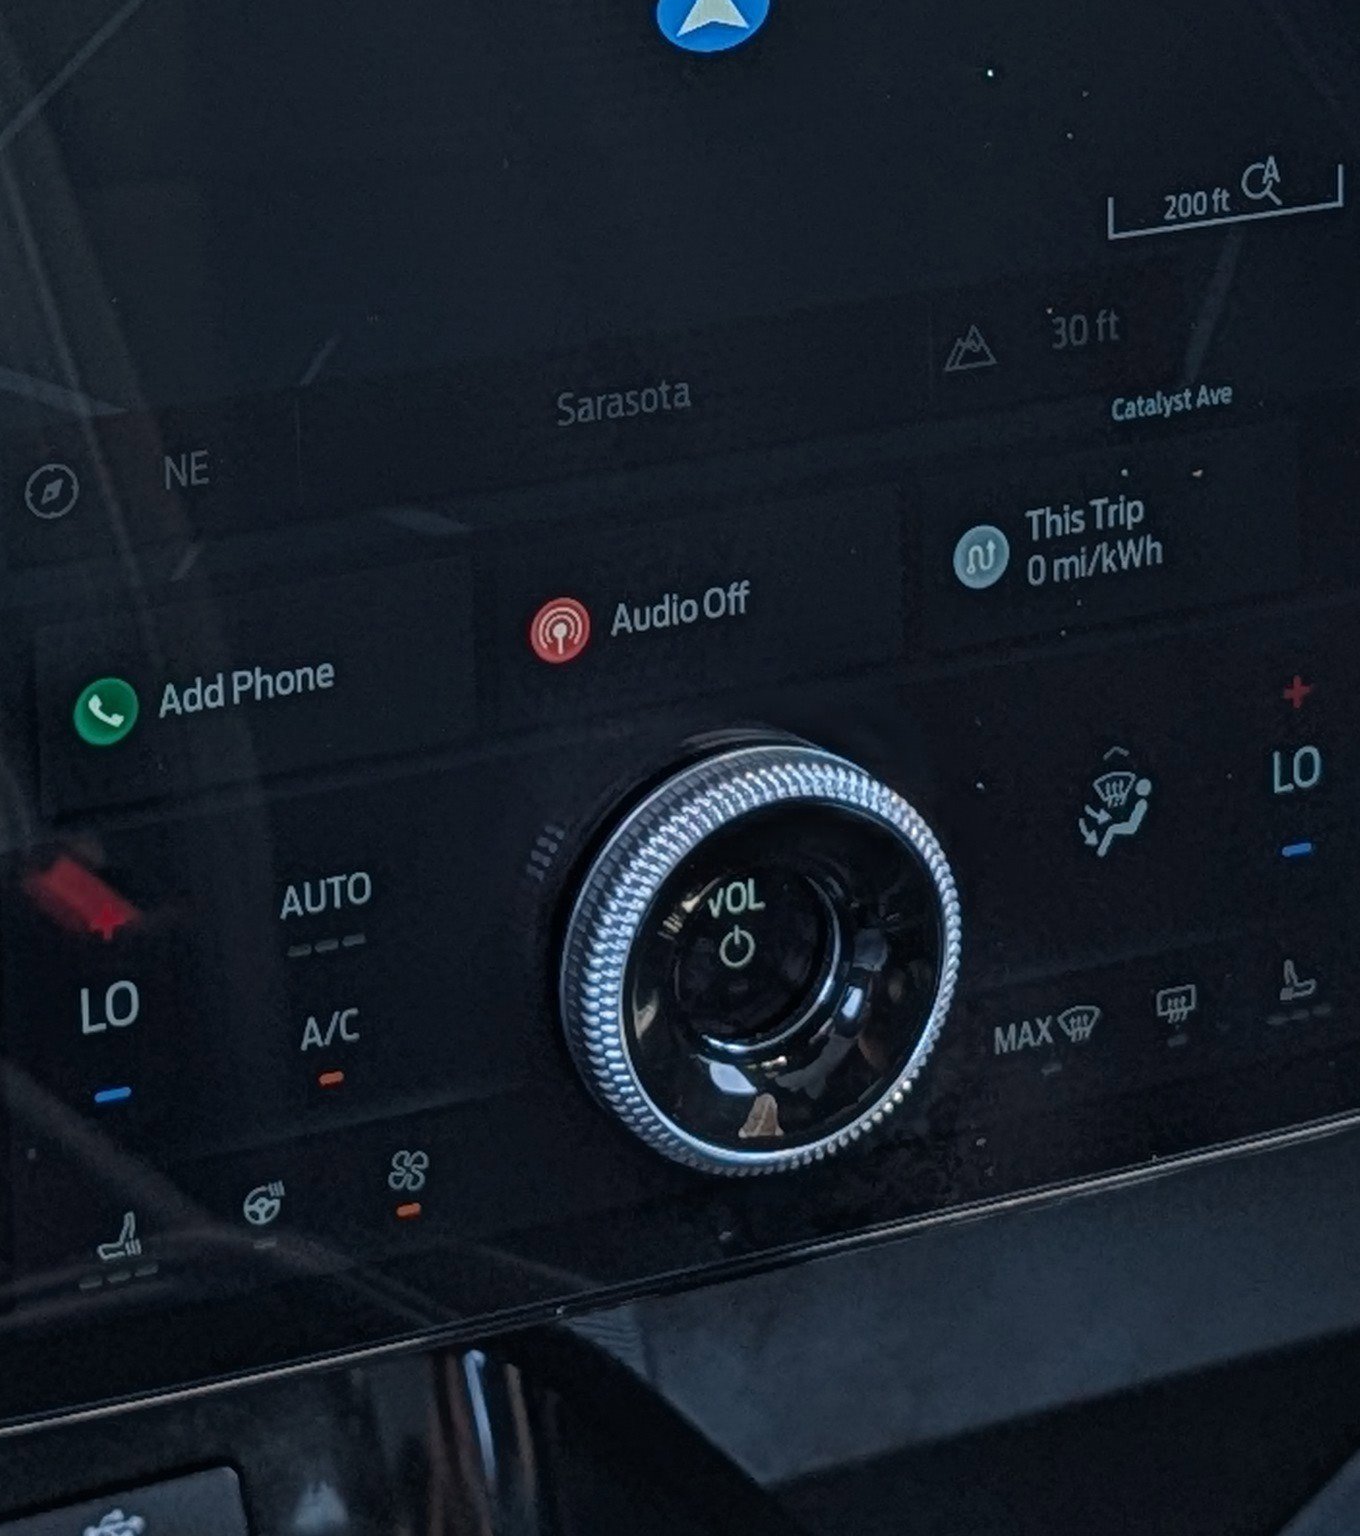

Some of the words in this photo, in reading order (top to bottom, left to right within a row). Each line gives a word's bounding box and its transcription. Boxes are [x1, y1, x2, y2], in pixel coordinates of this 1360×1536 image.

[1163, 192, 1208, 221] 200
[1211, 186, 1231, 212] ft
[1050, 315, 1089, 350] 30
[1095, 309, 1120, 341] ft
[557, 380, 692, 426] Sarasota
[1111, 387, 1193, 422] Catalyst
[1195, 384, 1233, 409] Ave
[164, 449, 210, 490] NE
[1024, 505, 1086, 542] This
[1089, 495, 1145, 531] Trip
[1027, 554, 1046, 586] 0
[1052, 534, 1164, 583] mi/kWh
[610, 593, 699, 638] Audio
[702, 579, 751, 620] Off
[158, 672, 226, 719] Add
[231, 662, 336, 705] Phone
[1272, 744, 1322, 795] LO
[279, 871, 373, 921] AUTO
[707, 878, 766, 918] VOL
[79, 979, 140, 1036] LO
[299, 1007, 361, 1052] A/C
[993, 1017, 1054, 1055] MAX
